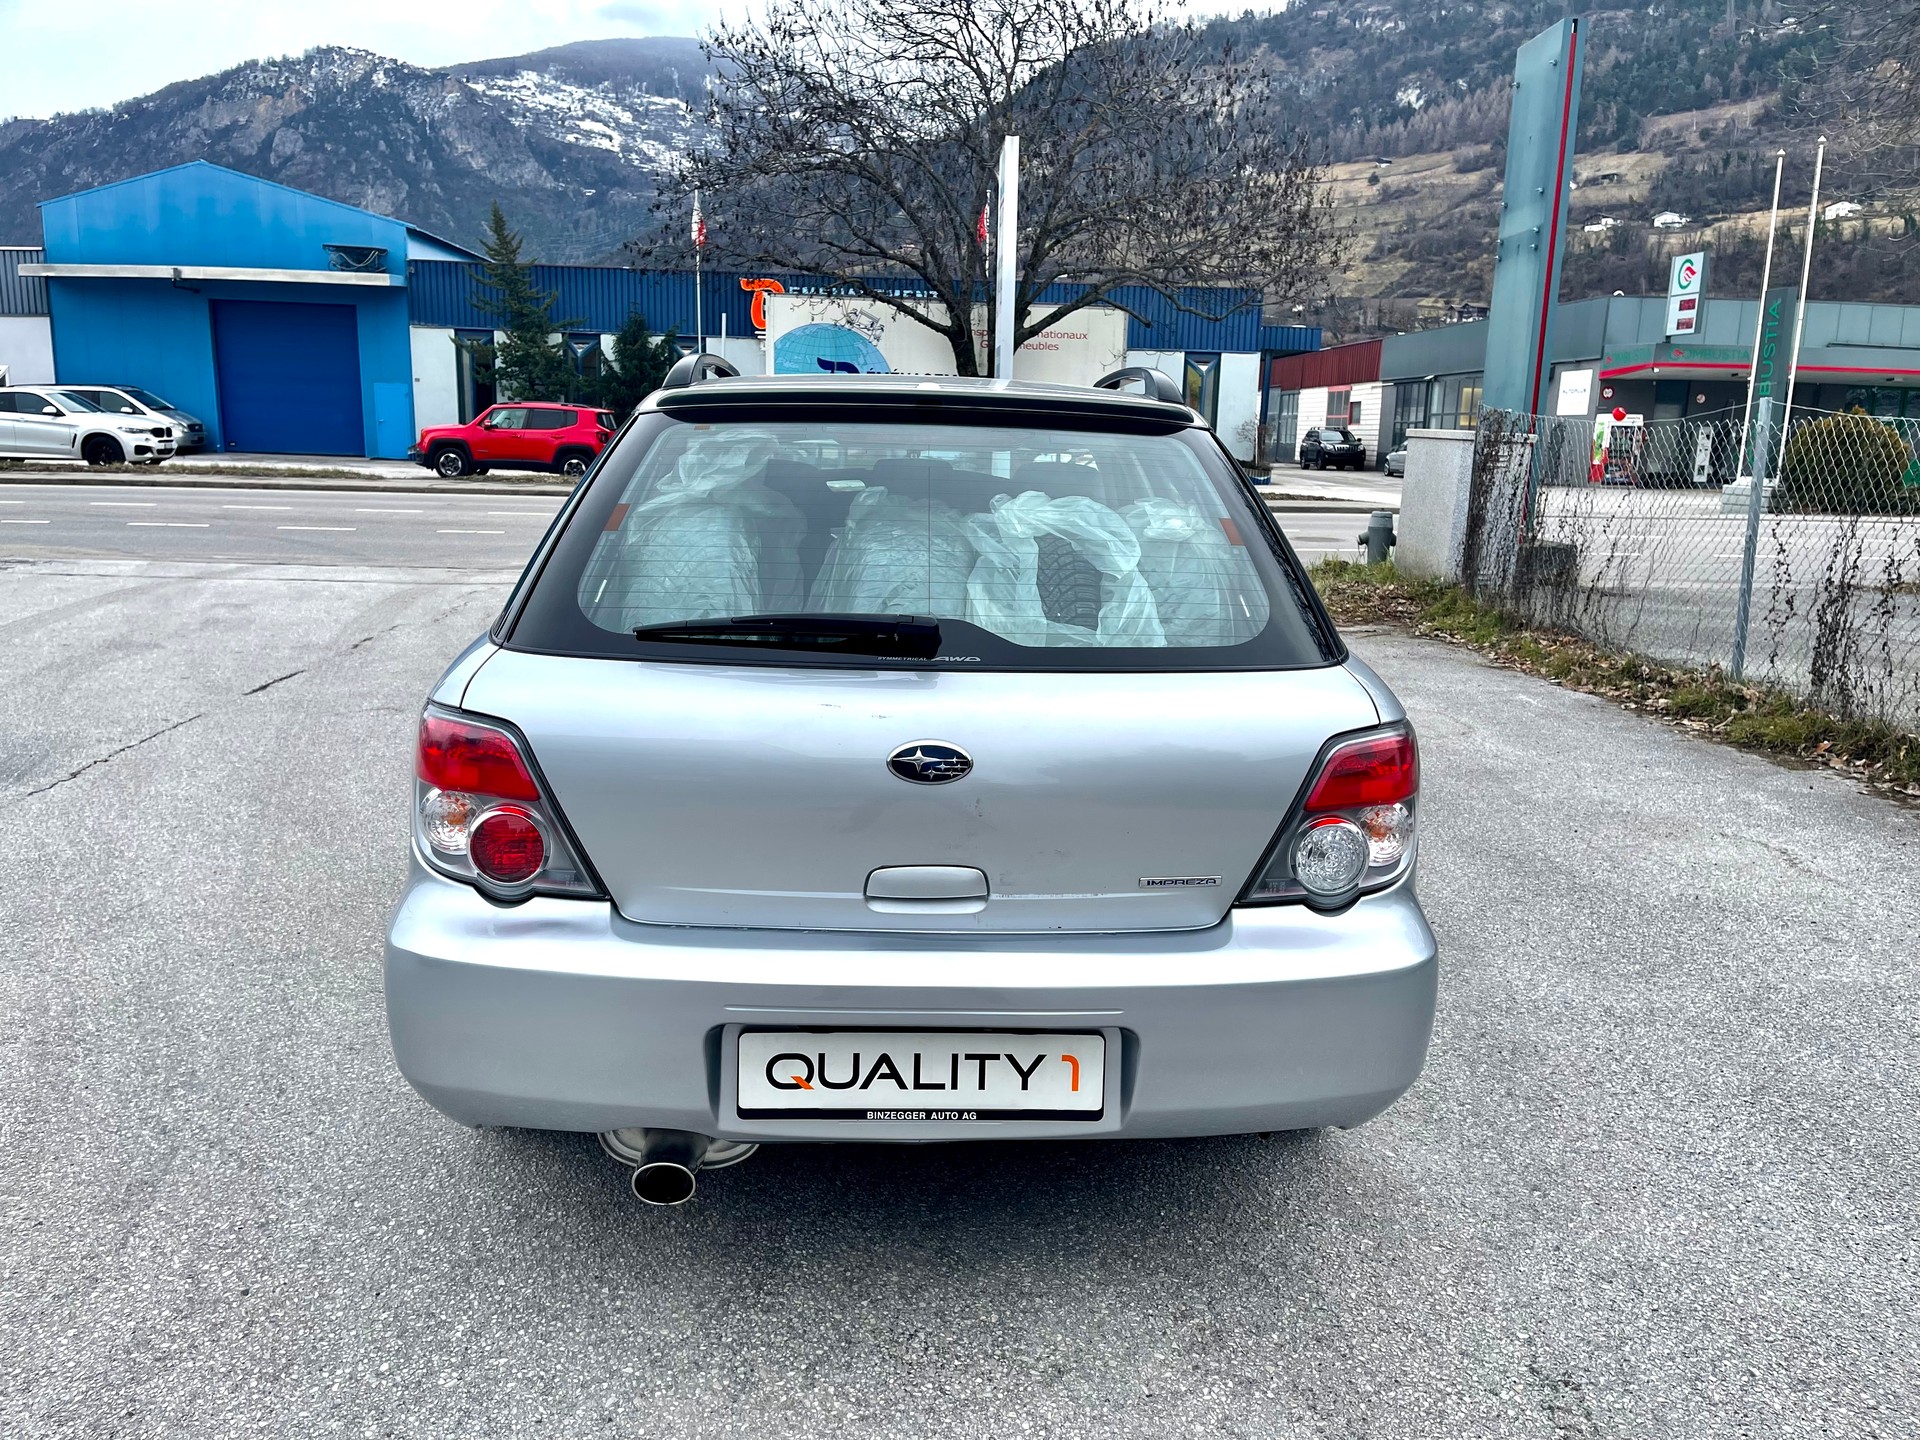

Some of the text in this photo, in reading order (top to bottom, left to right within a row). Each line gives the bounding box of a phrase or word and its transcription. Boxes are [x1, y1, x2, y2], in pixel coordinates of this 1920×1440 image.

[1036, 330, 1088, 340] nationaux
[1759, 297, 1782, 396] BUSTIA
[1146, 878, 1217, 886] IMPREZA
[764, 1052, 1081, 1092] QUALITY 1
[866, 1110, 977, 1121] BINZEGGER AUTO AG
